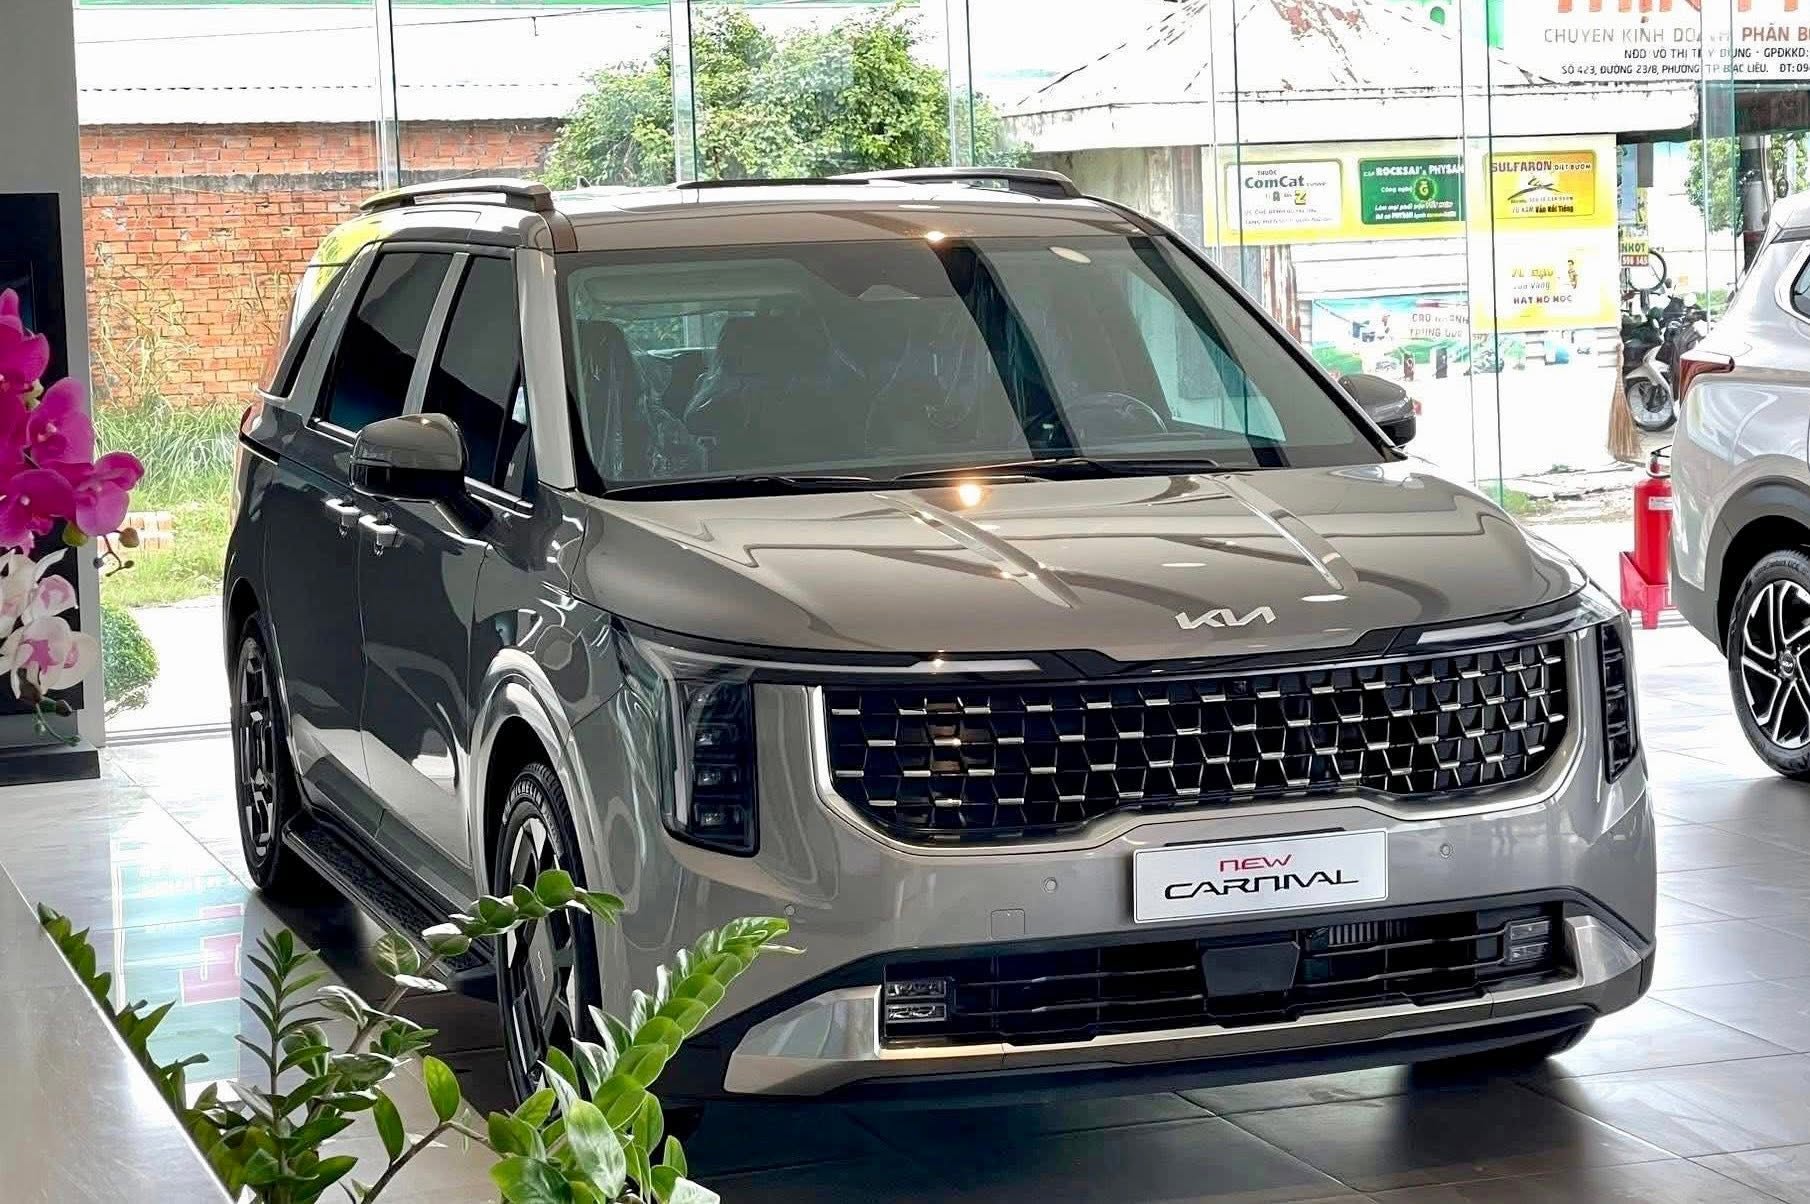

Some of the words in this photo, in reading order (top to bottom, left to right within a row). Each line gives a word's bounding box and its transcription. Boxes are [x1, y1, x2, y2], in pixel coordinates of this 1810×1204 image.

[1622, 27, 1664, 43] KINH
[1798, 26, 1810, 42] B
[1491, 160, 1552, 173] SULFARON
[1244, 174, 1305, 189] ComCat
[1175, 605, 1276, 630] KIA
[1219, 854, 1292, 873] NEW
[1164, 869, 1359, 900] CARNIVAL
